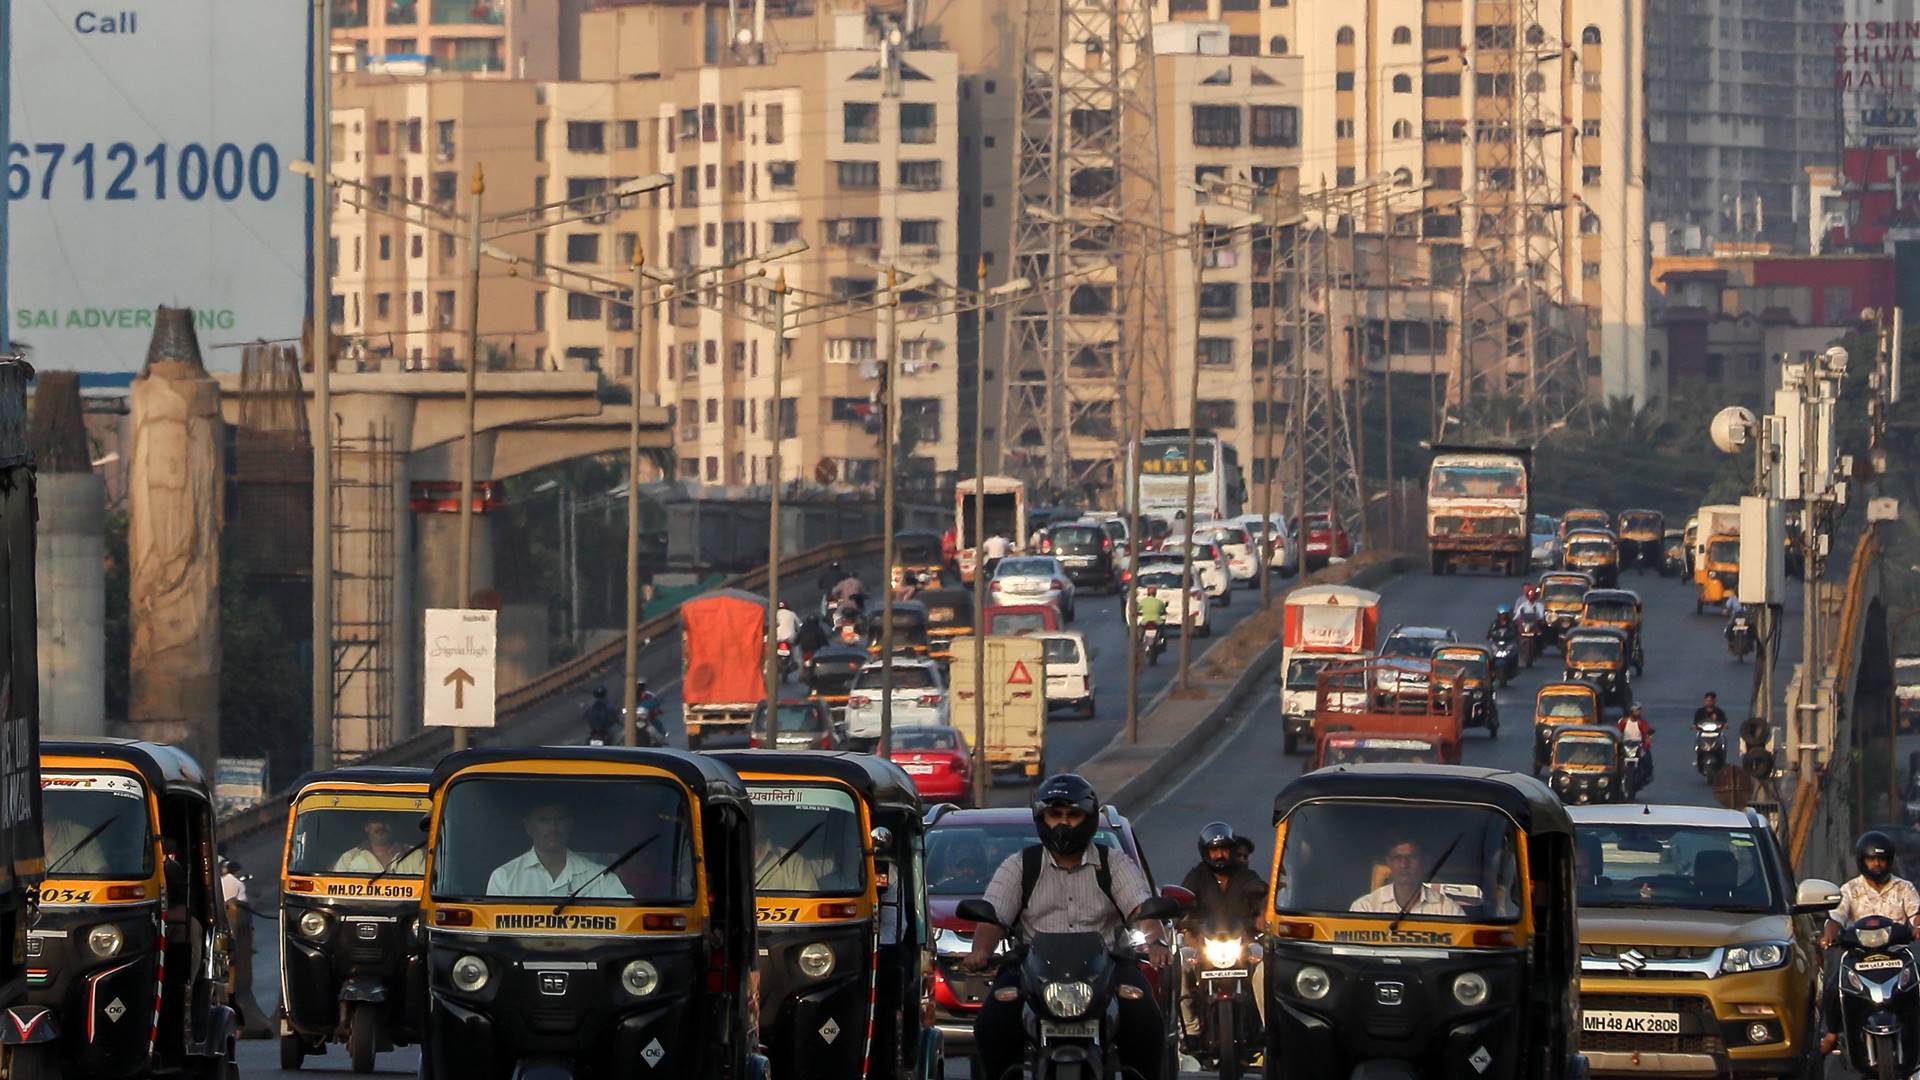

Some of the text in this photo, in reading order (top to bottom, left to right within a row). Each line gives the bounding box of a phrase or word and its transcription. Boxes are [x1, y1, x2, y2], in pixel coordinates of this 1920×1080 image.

[75, 11, 137, 34] Call
[1834, 70, 1913, 91] MALL
[7, 142, 280, 200] 67121000
[17, 308, 235, 329] SAI ADVERNG
[1584, 1016, 1605, 1030] MH
[1606, 1017, 1623, 1030] 48
[1625, 1018, 1646, 1031] AK
[645, 1048, 661, 1057] CNG
